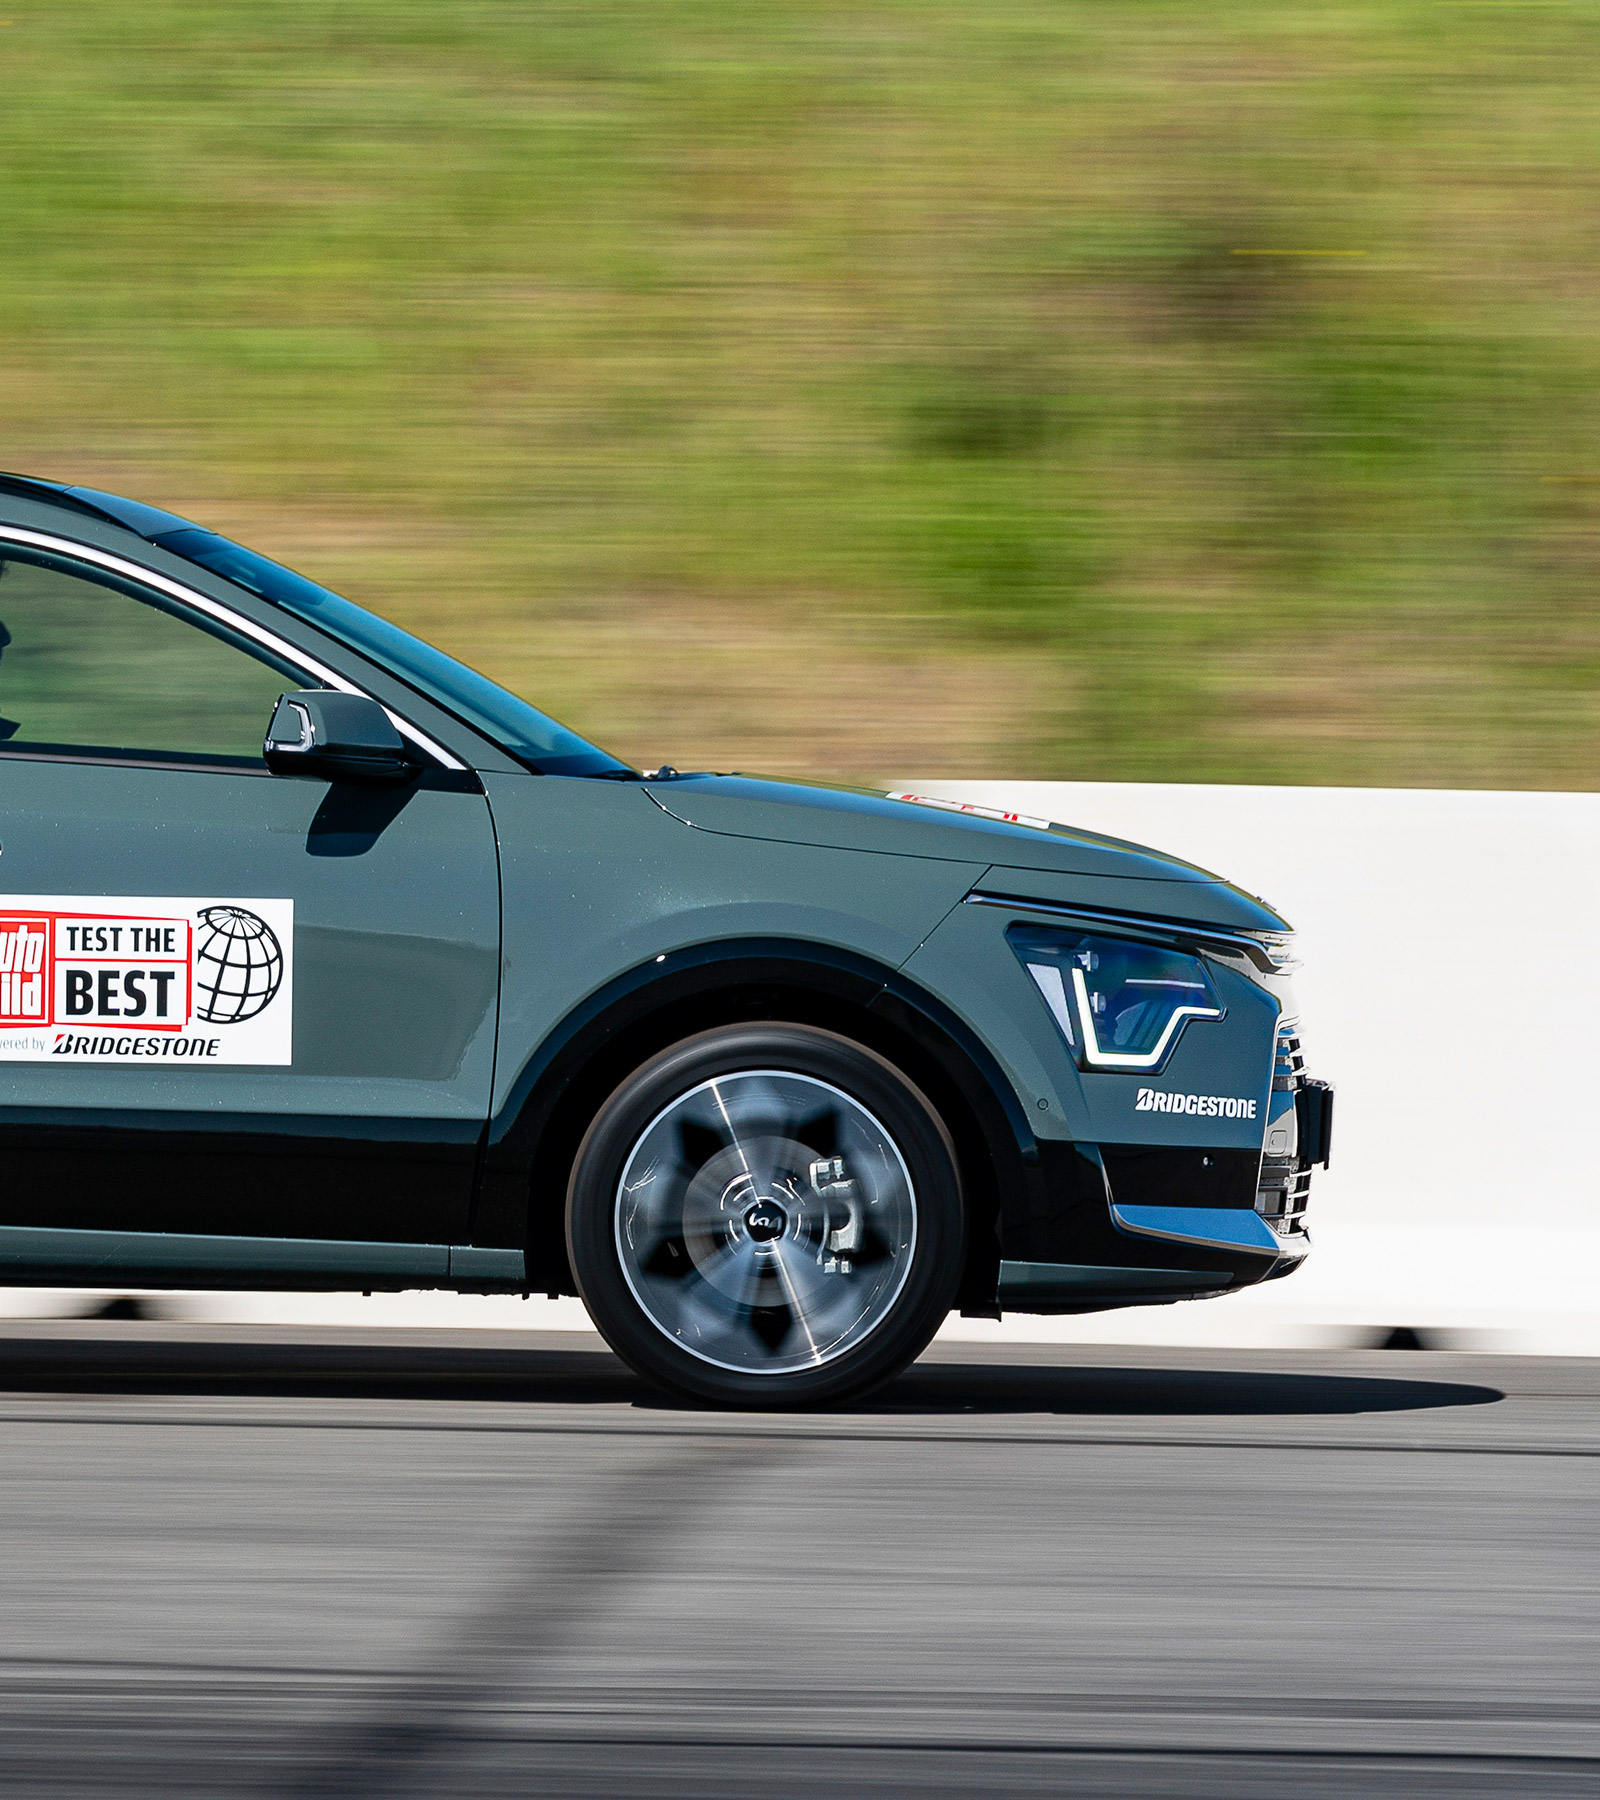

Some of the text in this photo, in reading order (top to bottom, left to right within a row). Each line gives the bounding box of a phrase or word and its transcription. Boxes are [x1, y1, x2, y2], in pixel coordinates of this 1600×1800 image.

[66, 926, 176, 952] TEST THE
[65, 969, 176, 1017] BEST
[32, 1037, 46, 1052] by
[52, 1033, 221, 1057] BRIDGESTONE
[1135, 1088, 1257, 1119] BRIDGESTONE
